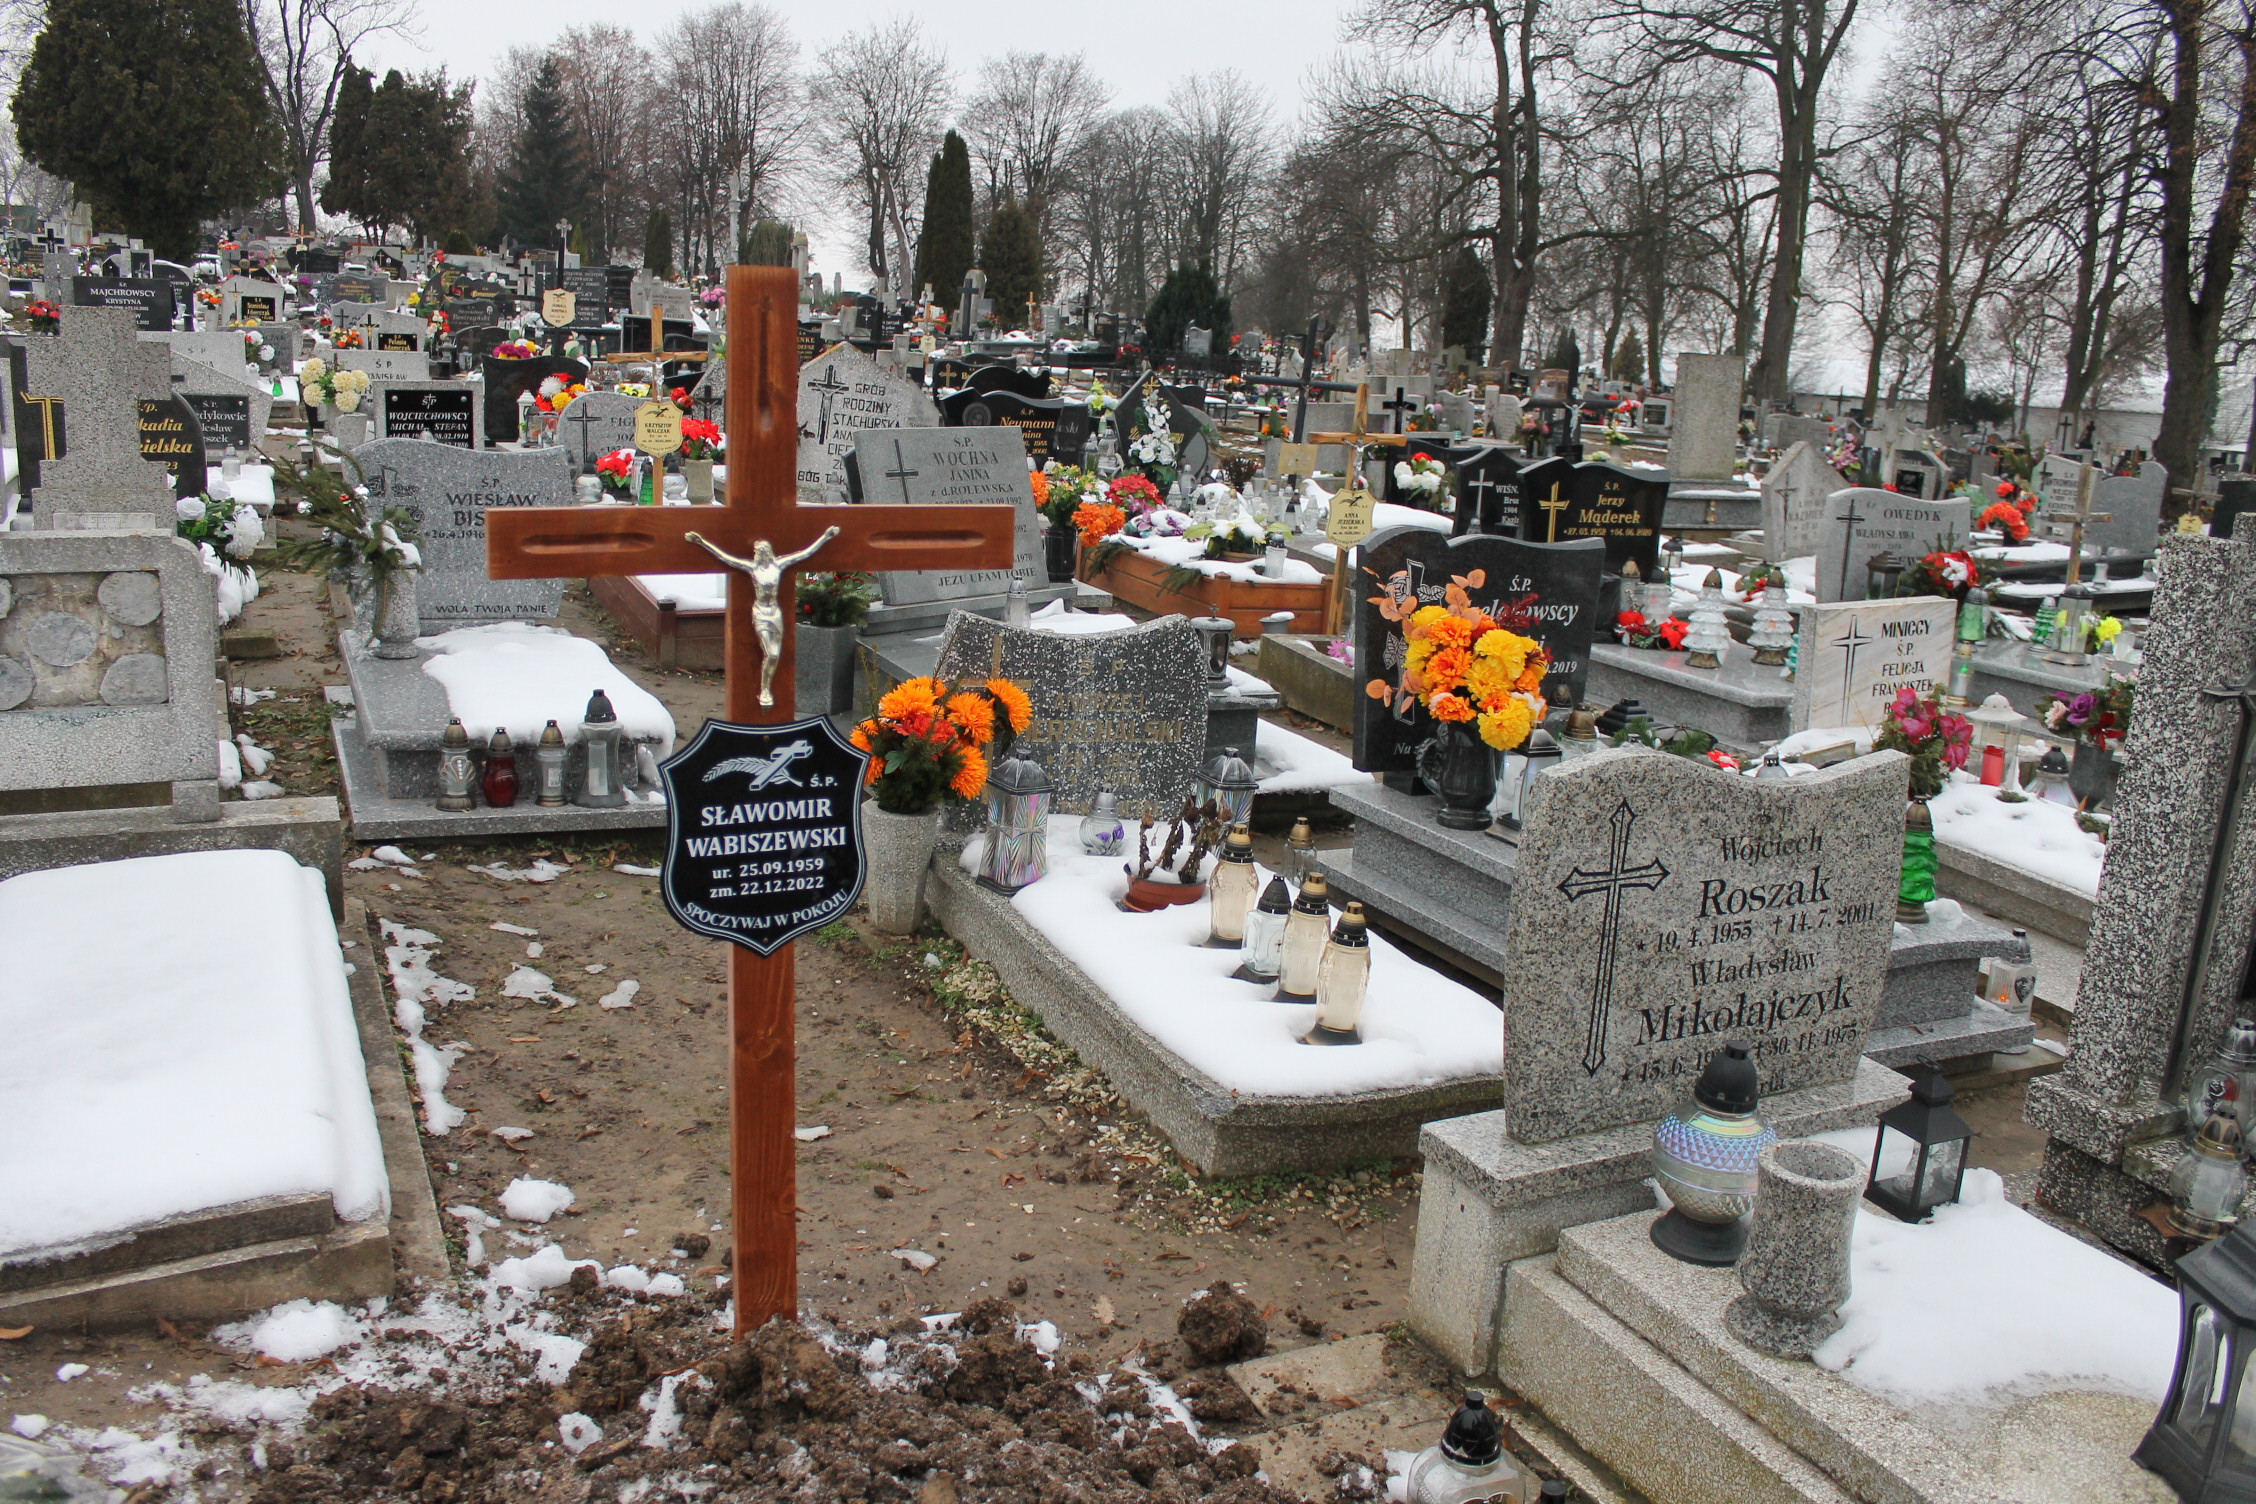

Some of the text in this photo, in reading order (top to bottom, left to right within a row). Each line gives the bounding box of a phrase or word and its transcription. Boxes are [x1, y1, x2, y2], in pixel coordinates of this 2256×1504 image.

[90, 288, 156, 297] MAJCHROWSCY
[842, 397, 892, 415] RODZINY
[139, 418, 184, 431] kadia
[197, 410, 247, 422] dykowie
[388, 412, 470, 420] WOJCIECHOWSCY
[1000, 416, 1055, 428] Neumann
[201, 423, 233, 433] lesław
[434, 423, 468, 431] STEFAN
[1021, 430, 1041, 438] nina
[950, 468, 991, 481] JANINA
[447, 493, 537, 507] WIESŁAW
[1596, 494, 1626, 508] Jerzy
[1578, 509, 1641, 526] Mąderek
[1883, 508, 1942, 521] OWEDYK
[938, 567, 1037, 587] JEZU UFAM TOBIE
[1509, 575, 1531, 591] Ś.P.
[436, 604, 547, 614] WOLA TWOJA PANIE
[1880, 619, 1932, 639] MINICCY
[1881, 659, 1925, 677] FELICJA
[1053, 693, 1146, 713] ANDRZEJ
[1025, 719, 1184, 743] IERZCHALSKI
[809, 773, 838, 787] Ś. P.
[700, 798, 833, 827] SŁAWOMIR
[685, 826, 848, 858] WABISZEWSKI
[1719, 826, 1823, 868] Wojciech
[711, 857, 825, 879] ur. 25.09.1959
[709, 876, 825, 898] zm. 22.12.2022
[1698, 864, 1832, 920] Roszak
[682, 888, 849, 929] SPOCZYWAJ W POKOJU
[1711, 919, 1753, 945] 1955
[1690, 949, 1820, 988] Władysław
[1634, 975, 1853, 1048] Mikołajczyk
